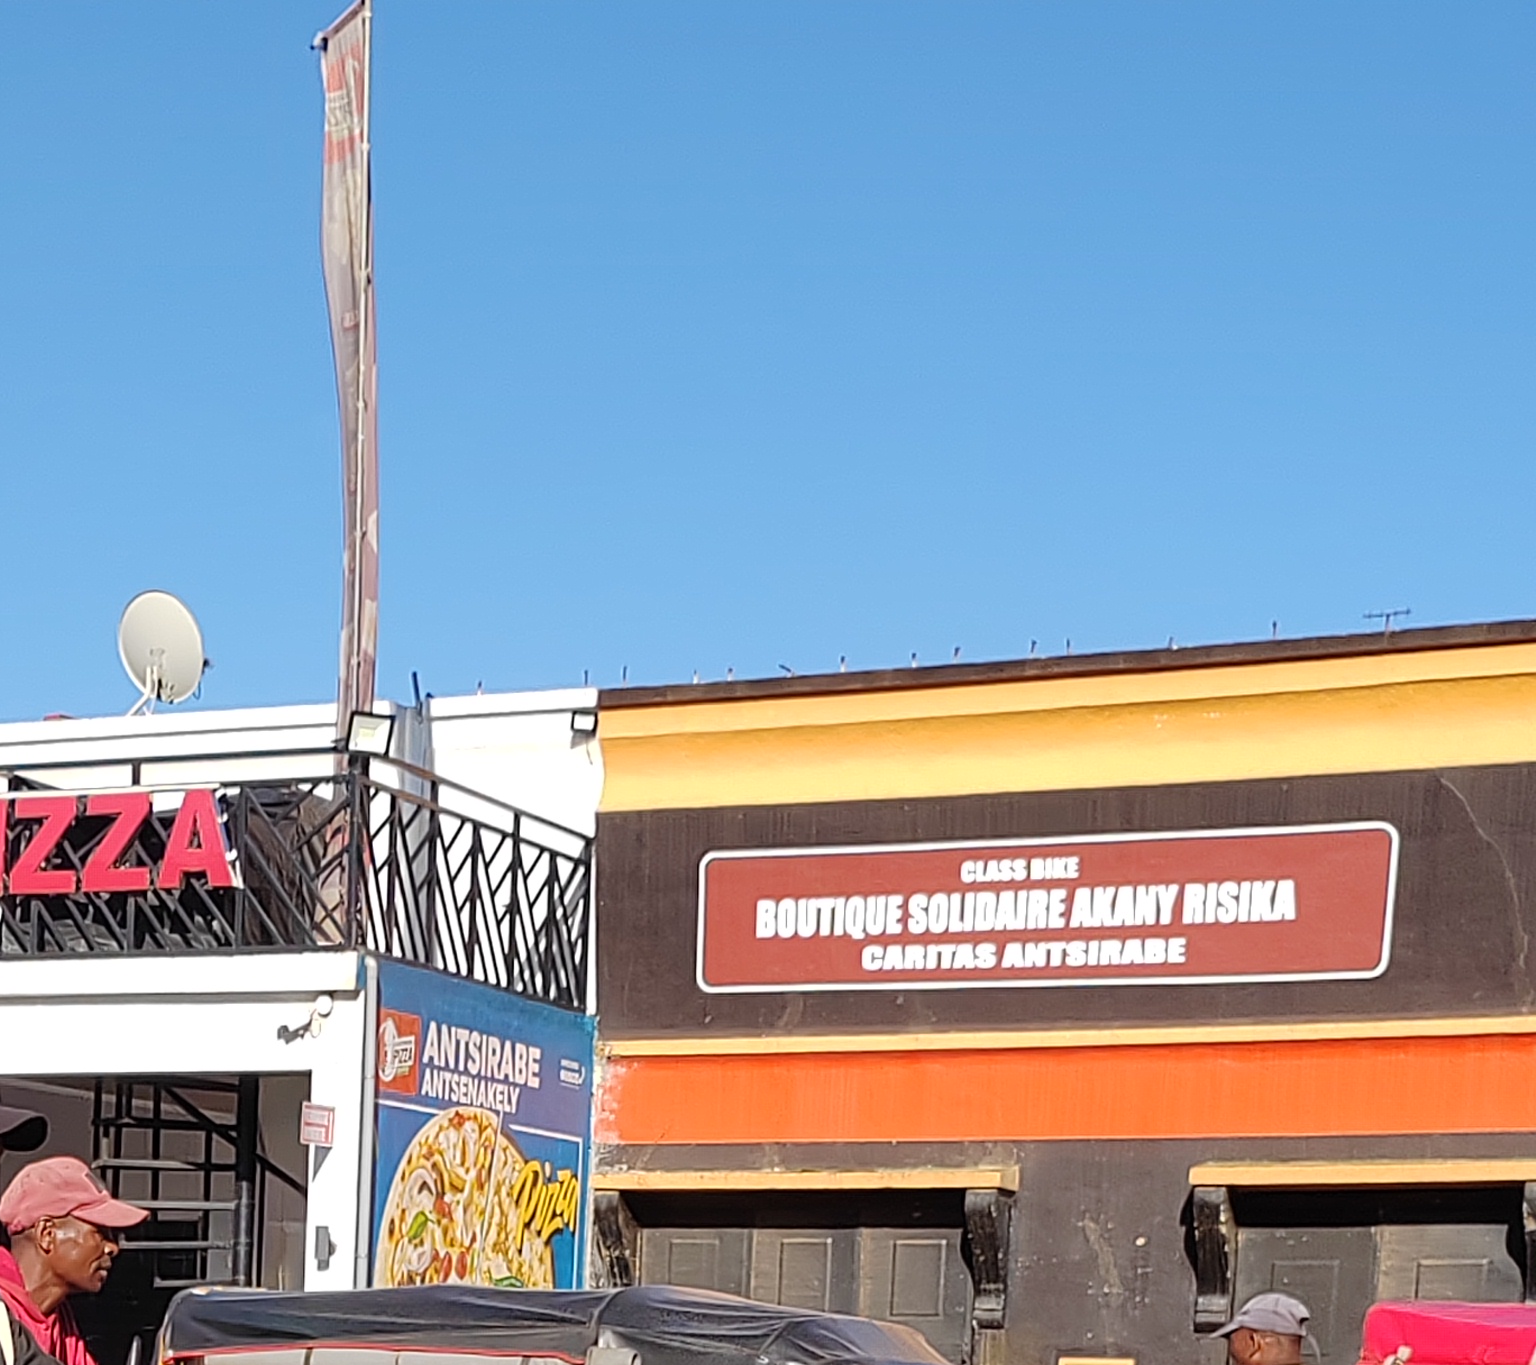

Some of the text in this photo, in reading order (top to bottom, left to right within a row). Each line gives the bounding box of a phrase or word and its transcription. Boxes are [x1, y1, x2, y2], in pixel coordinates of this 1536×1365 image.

[960, 856, 1080, 883] CLASS BIKE
[755, 879, 1296, 940] BOUTIQUE SOLIDAIRE AKANY RISIKA
[861, 937, 1187, 971] CARITAS ANTSIRABE
[422, 1020, 542, 1089] ANTSIRABE
[421, 1068, 521, 1114] ANTSENAKELY
[512, 1160, 578, 1251] Pizza
